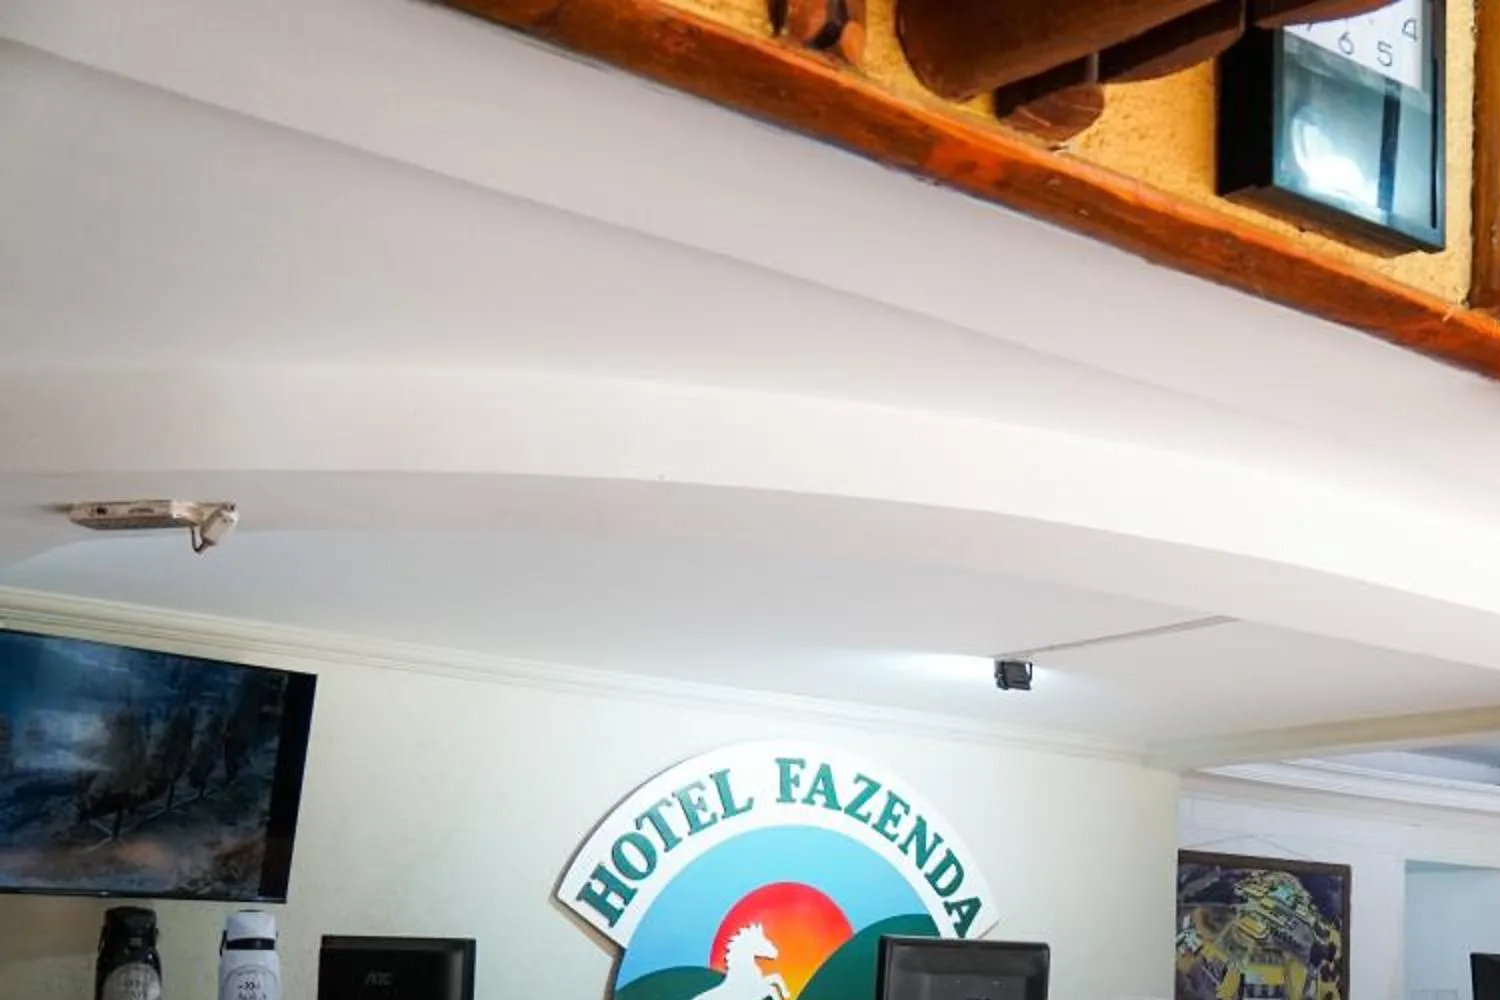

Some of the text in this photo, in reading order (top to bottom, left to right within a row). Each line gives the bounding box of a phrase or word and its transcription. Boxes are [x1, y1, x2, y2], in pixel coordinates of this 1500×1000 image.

[1337, 32, 1354, 56] 6
[1377, 40, 1393, 67] 5
[576, 757, 982, 939] HOTEL FAZENDA
